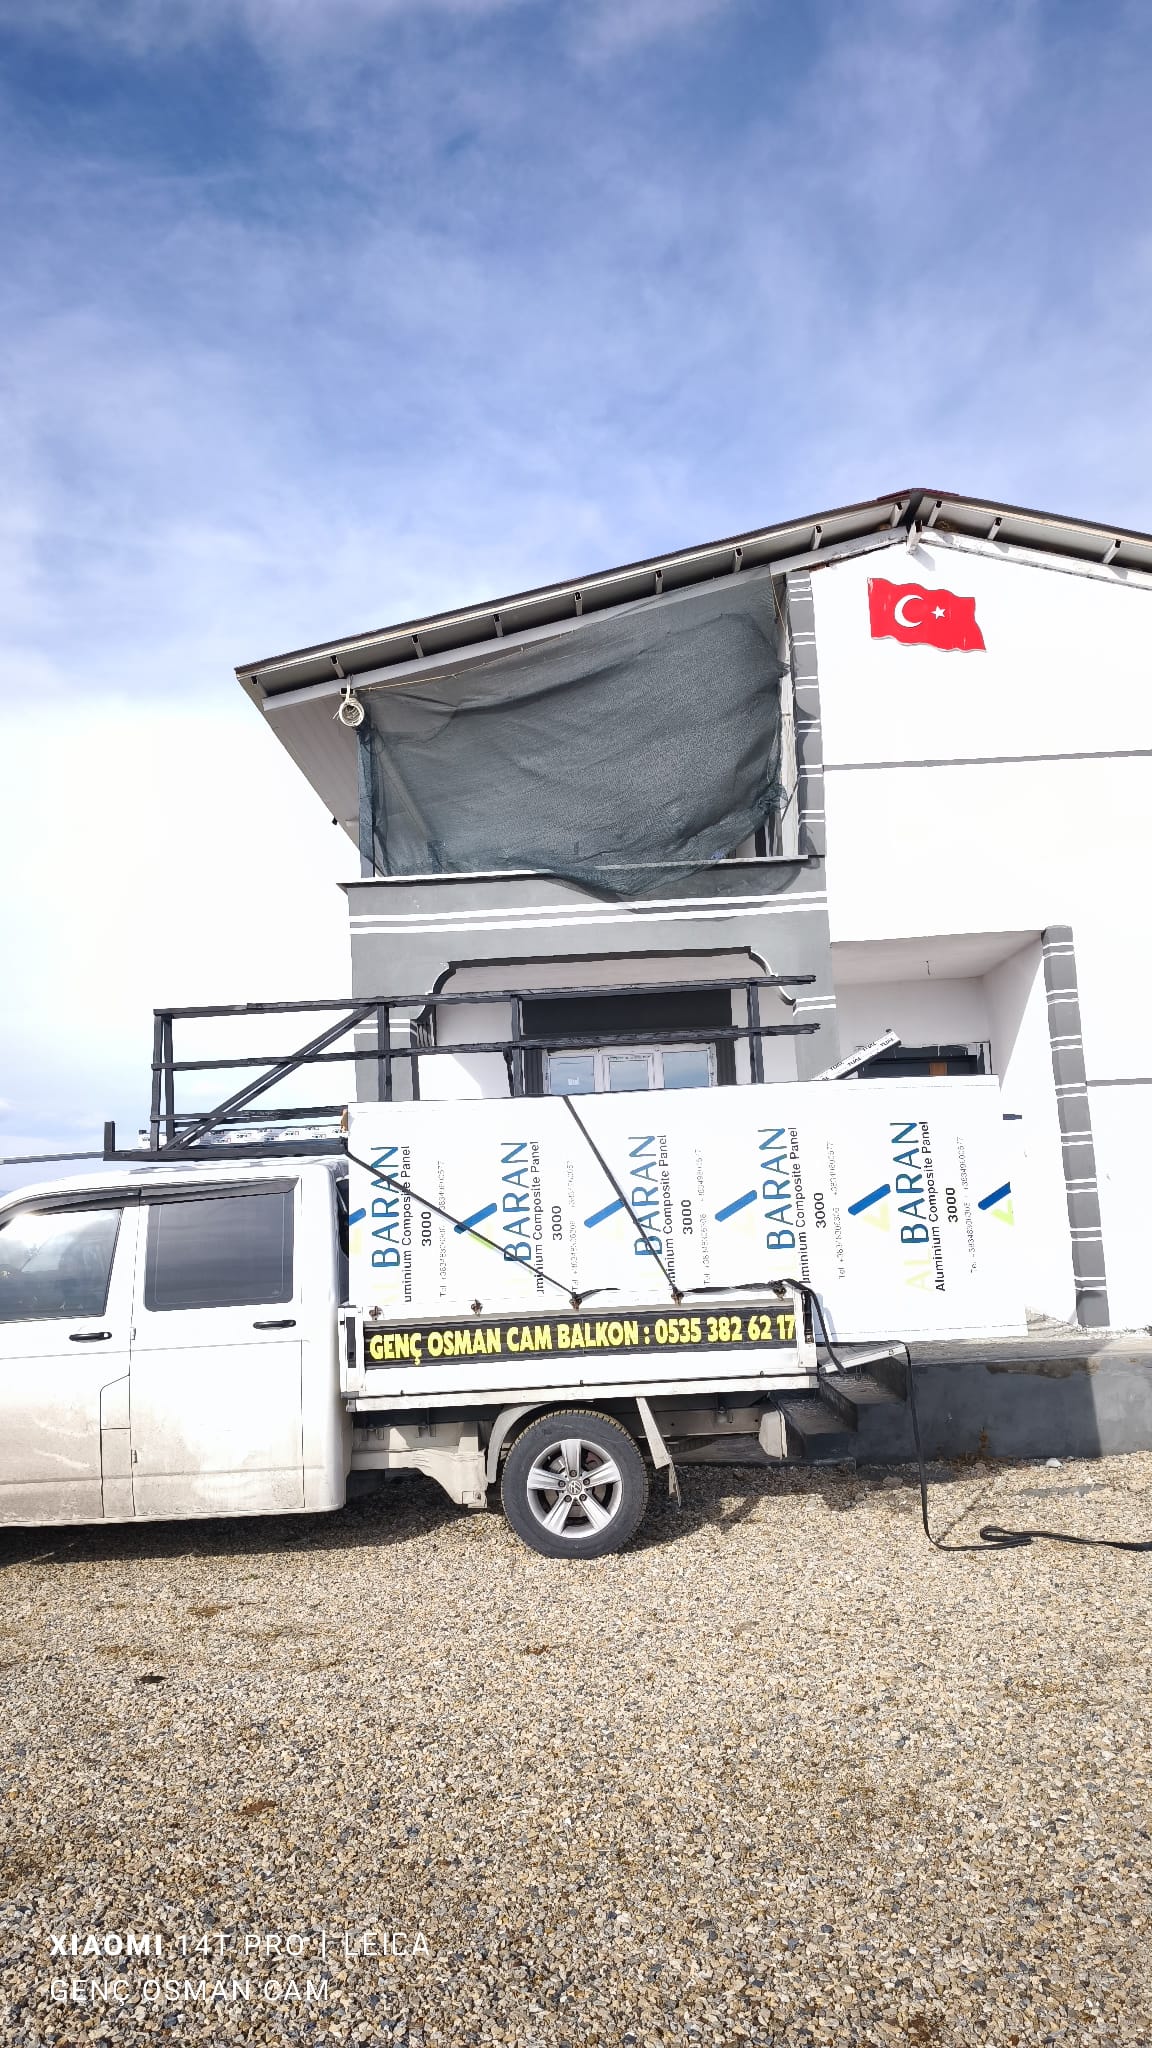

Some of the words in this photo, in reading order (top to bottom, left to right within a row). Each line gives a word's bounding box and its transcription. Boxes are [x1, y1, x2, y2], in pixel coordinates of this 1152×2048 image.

[657, 1134, 669, 1167] Panel
[787, 1127, 800, 1160] Panel
[918, 1121, 932, 1154] Panel
[400, 1146, 411, 1178] Panel
[529, 1141, 540, 1173] Panel
[659, 1170, 674, 1235] Composite
[790, 1163, 806, 1228] Composite
[923, 1157, 939, 1223] Composite
[947, 1187, 960, 1223] 3000
[530, 1177, 544, 1241] Composite
[551, 1205, 563, 1241] 3000
[680, 1199, 694, 1235] 3000
[815, 1192, 827, 1229] 3000
[420, 1211, 432, 1247] 3000
[401, 1250, 413, 1303] uminium
[931, 1226, 946, 1292] Aluminium
[369, 1332, 422, 1365] GENÇ
[427, 1327, 501, 1357] OSMAN
[507, 1324, 552, 1352] CAM
[556, 1320, 639, 1350] BALKON
[654, 1317, 702, 1344] 0535
[706, 1314, 742, 1341] 382
[747, 1314, 773, 1341] 62
[776, 1314, 796, 1340] 17
